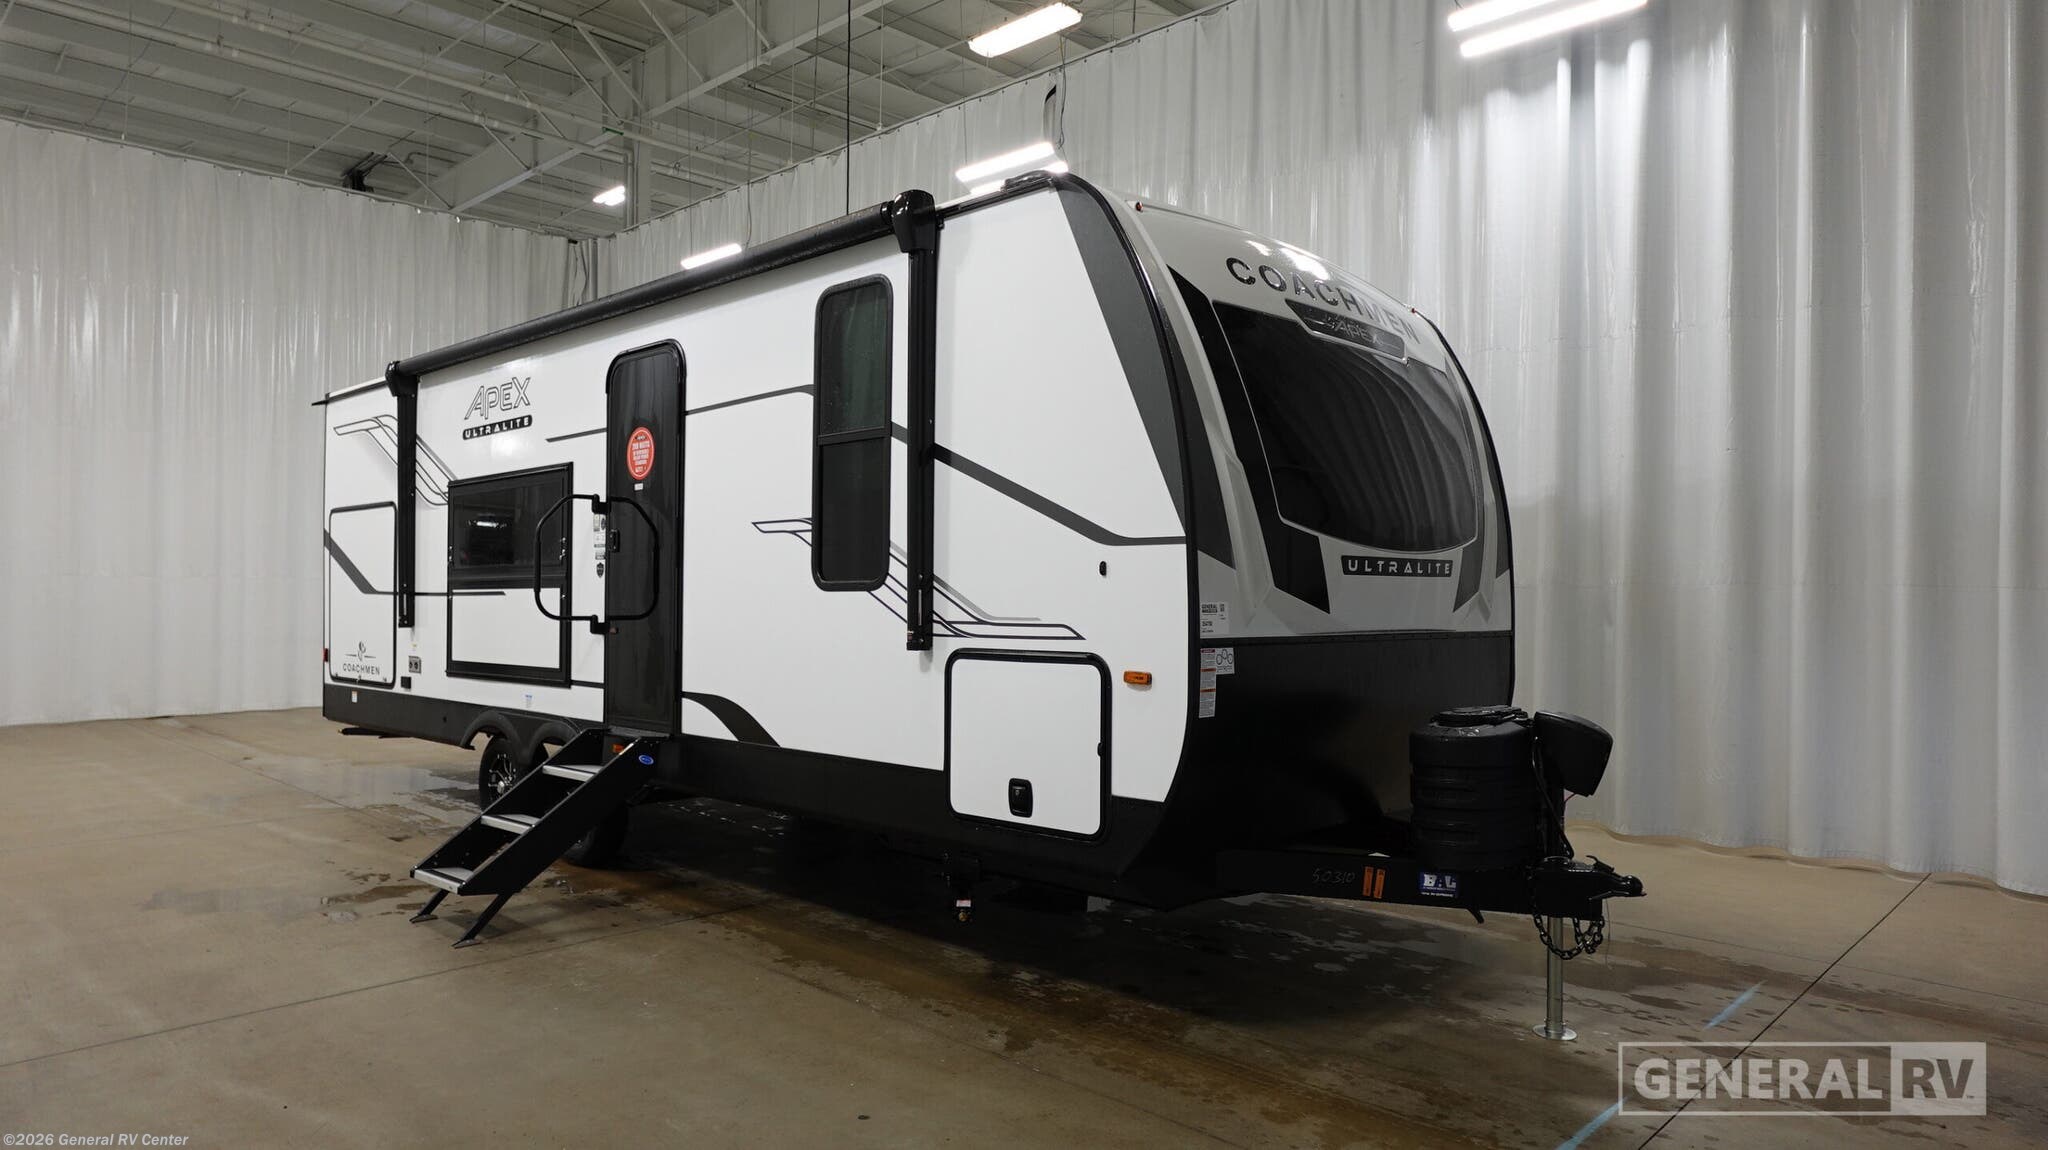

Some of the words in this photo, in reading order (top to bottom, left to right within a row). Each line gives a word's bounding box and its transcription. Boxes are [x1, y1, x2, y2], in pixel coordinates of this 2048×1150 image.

[1226, 257, 1421, 344] COACHMEN
[1333, 319, 1384, 346] APEX
[464, 376, 531, 420] APEX
[465, 416, 529, 438] ULTRALITE
[1348, 559, 1450, 575] ULTRALITE
[342, 663, 380, 676] COACHMEN
